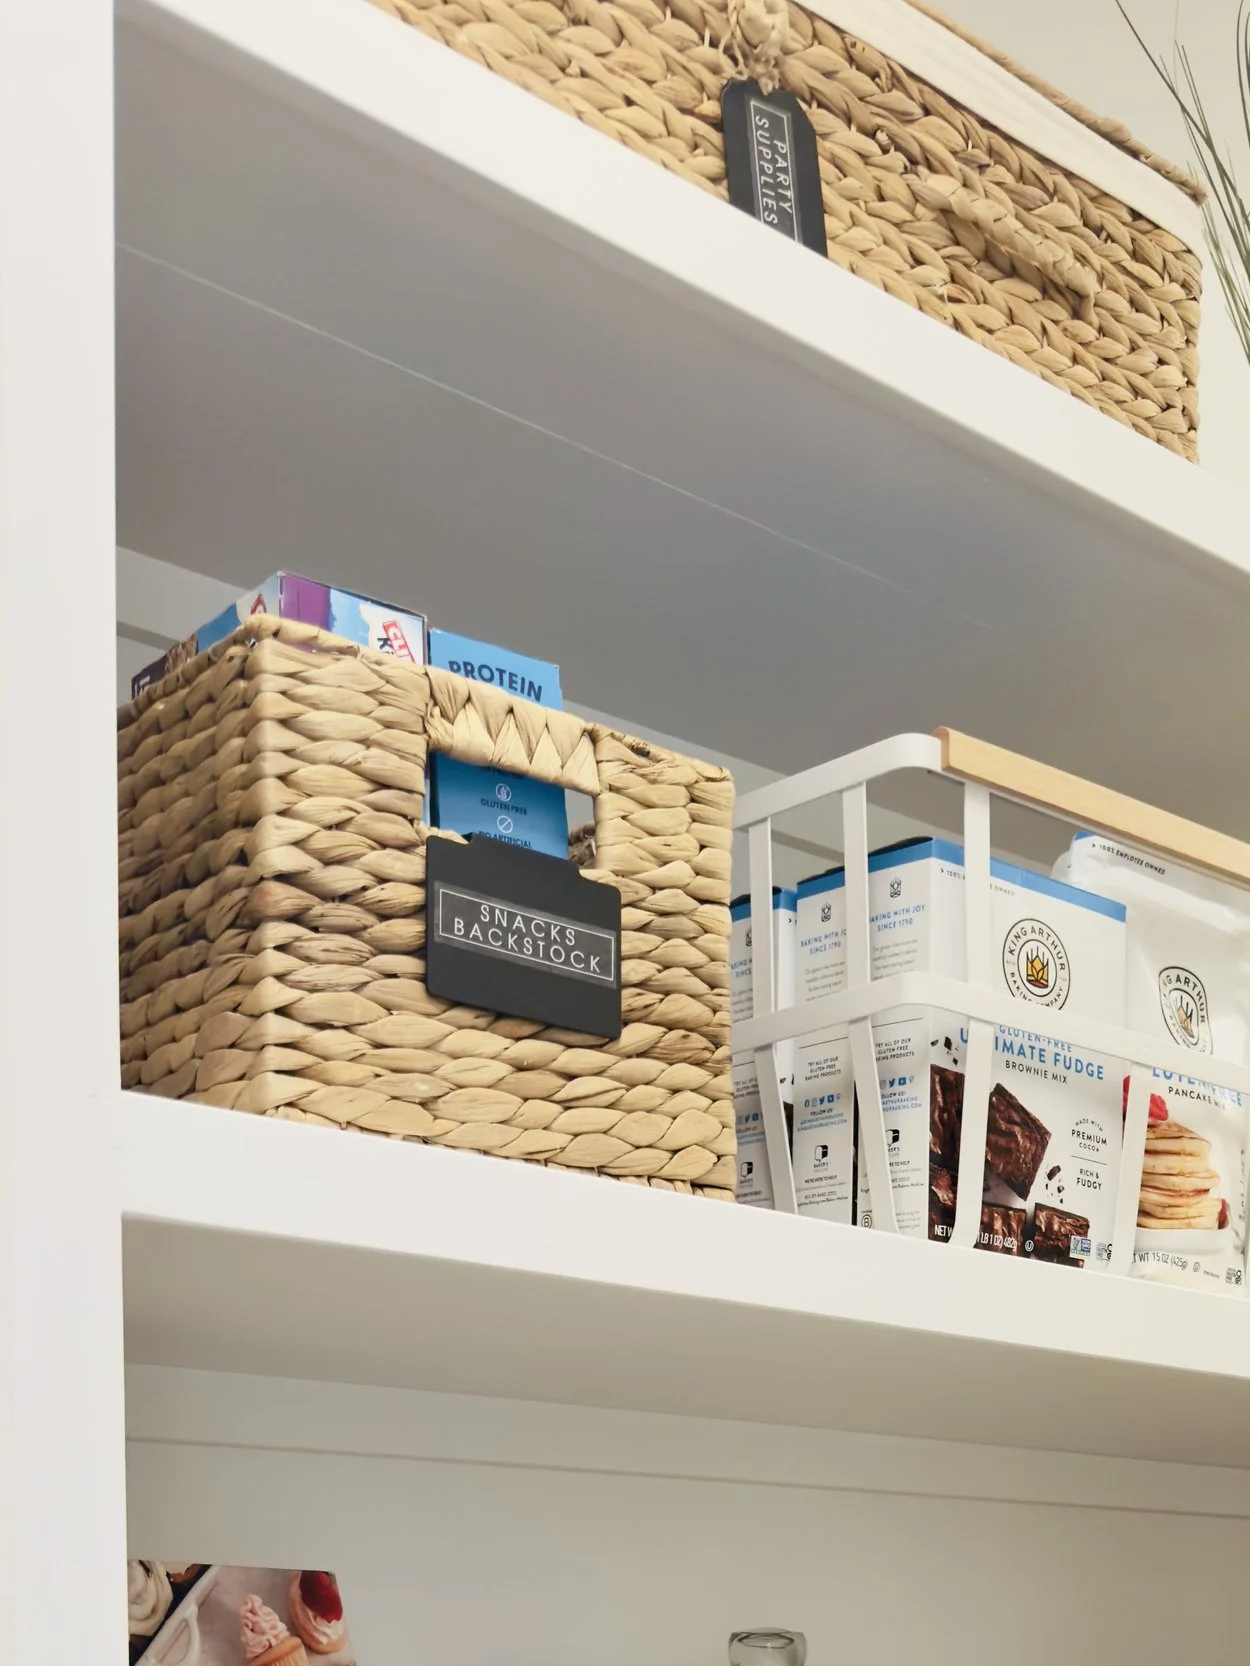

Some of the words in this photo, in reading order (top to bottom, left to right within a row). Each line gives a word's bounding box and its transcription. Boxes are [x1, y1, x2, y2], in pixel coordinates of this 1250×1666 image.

[755, 115, 778, 225] SUPPLIES
[773, 139, 792, 215] PARTY
[448, 660, 543, 702] PROTEIN
[1115, 849, 1144, 867] EMPLOYEE
[1144, 860, 1166, 876] OWNED
[871, 911, 892, 924] AKING
[893, 907, 911, 918] WITH
[912, 903, 926, 915] JOY
[877, 921, 897, 933] SINCE
[898, 917, 914, 929] 1790
[480, 904, 577, 947] SNACKS
[454, 917, 601, 974] BACKSTOCK
[1008, 928, 1028, 957] KING
[1030, 925, 1066, 972] ARTHUR
[1175, 973, 1206, 1024] ARTHUR
[1005, 1059, 1049, 1080] BROWNIE
[1051, 1071, 1068, 1085] MIX
[1053, 1051, 1105, 1081] FUDGE
[1168, 1085, 1212, 1104] PANCAKE
[1074, 1118, 1089, 1127] MADE
[1071, 1129, 1108, 1146] PREMIUM
[1079, 1142, 1100, 1152] COCOA
[1076, 1177, 1103, 1191] FUDGY
[1079, 1167, 1093, 1178] RICH
[1094, 1171, 1100, 1179] &
[934, 1223, 948, 1237] NET
[1170, 1254, 1189, 1271] (425g)
